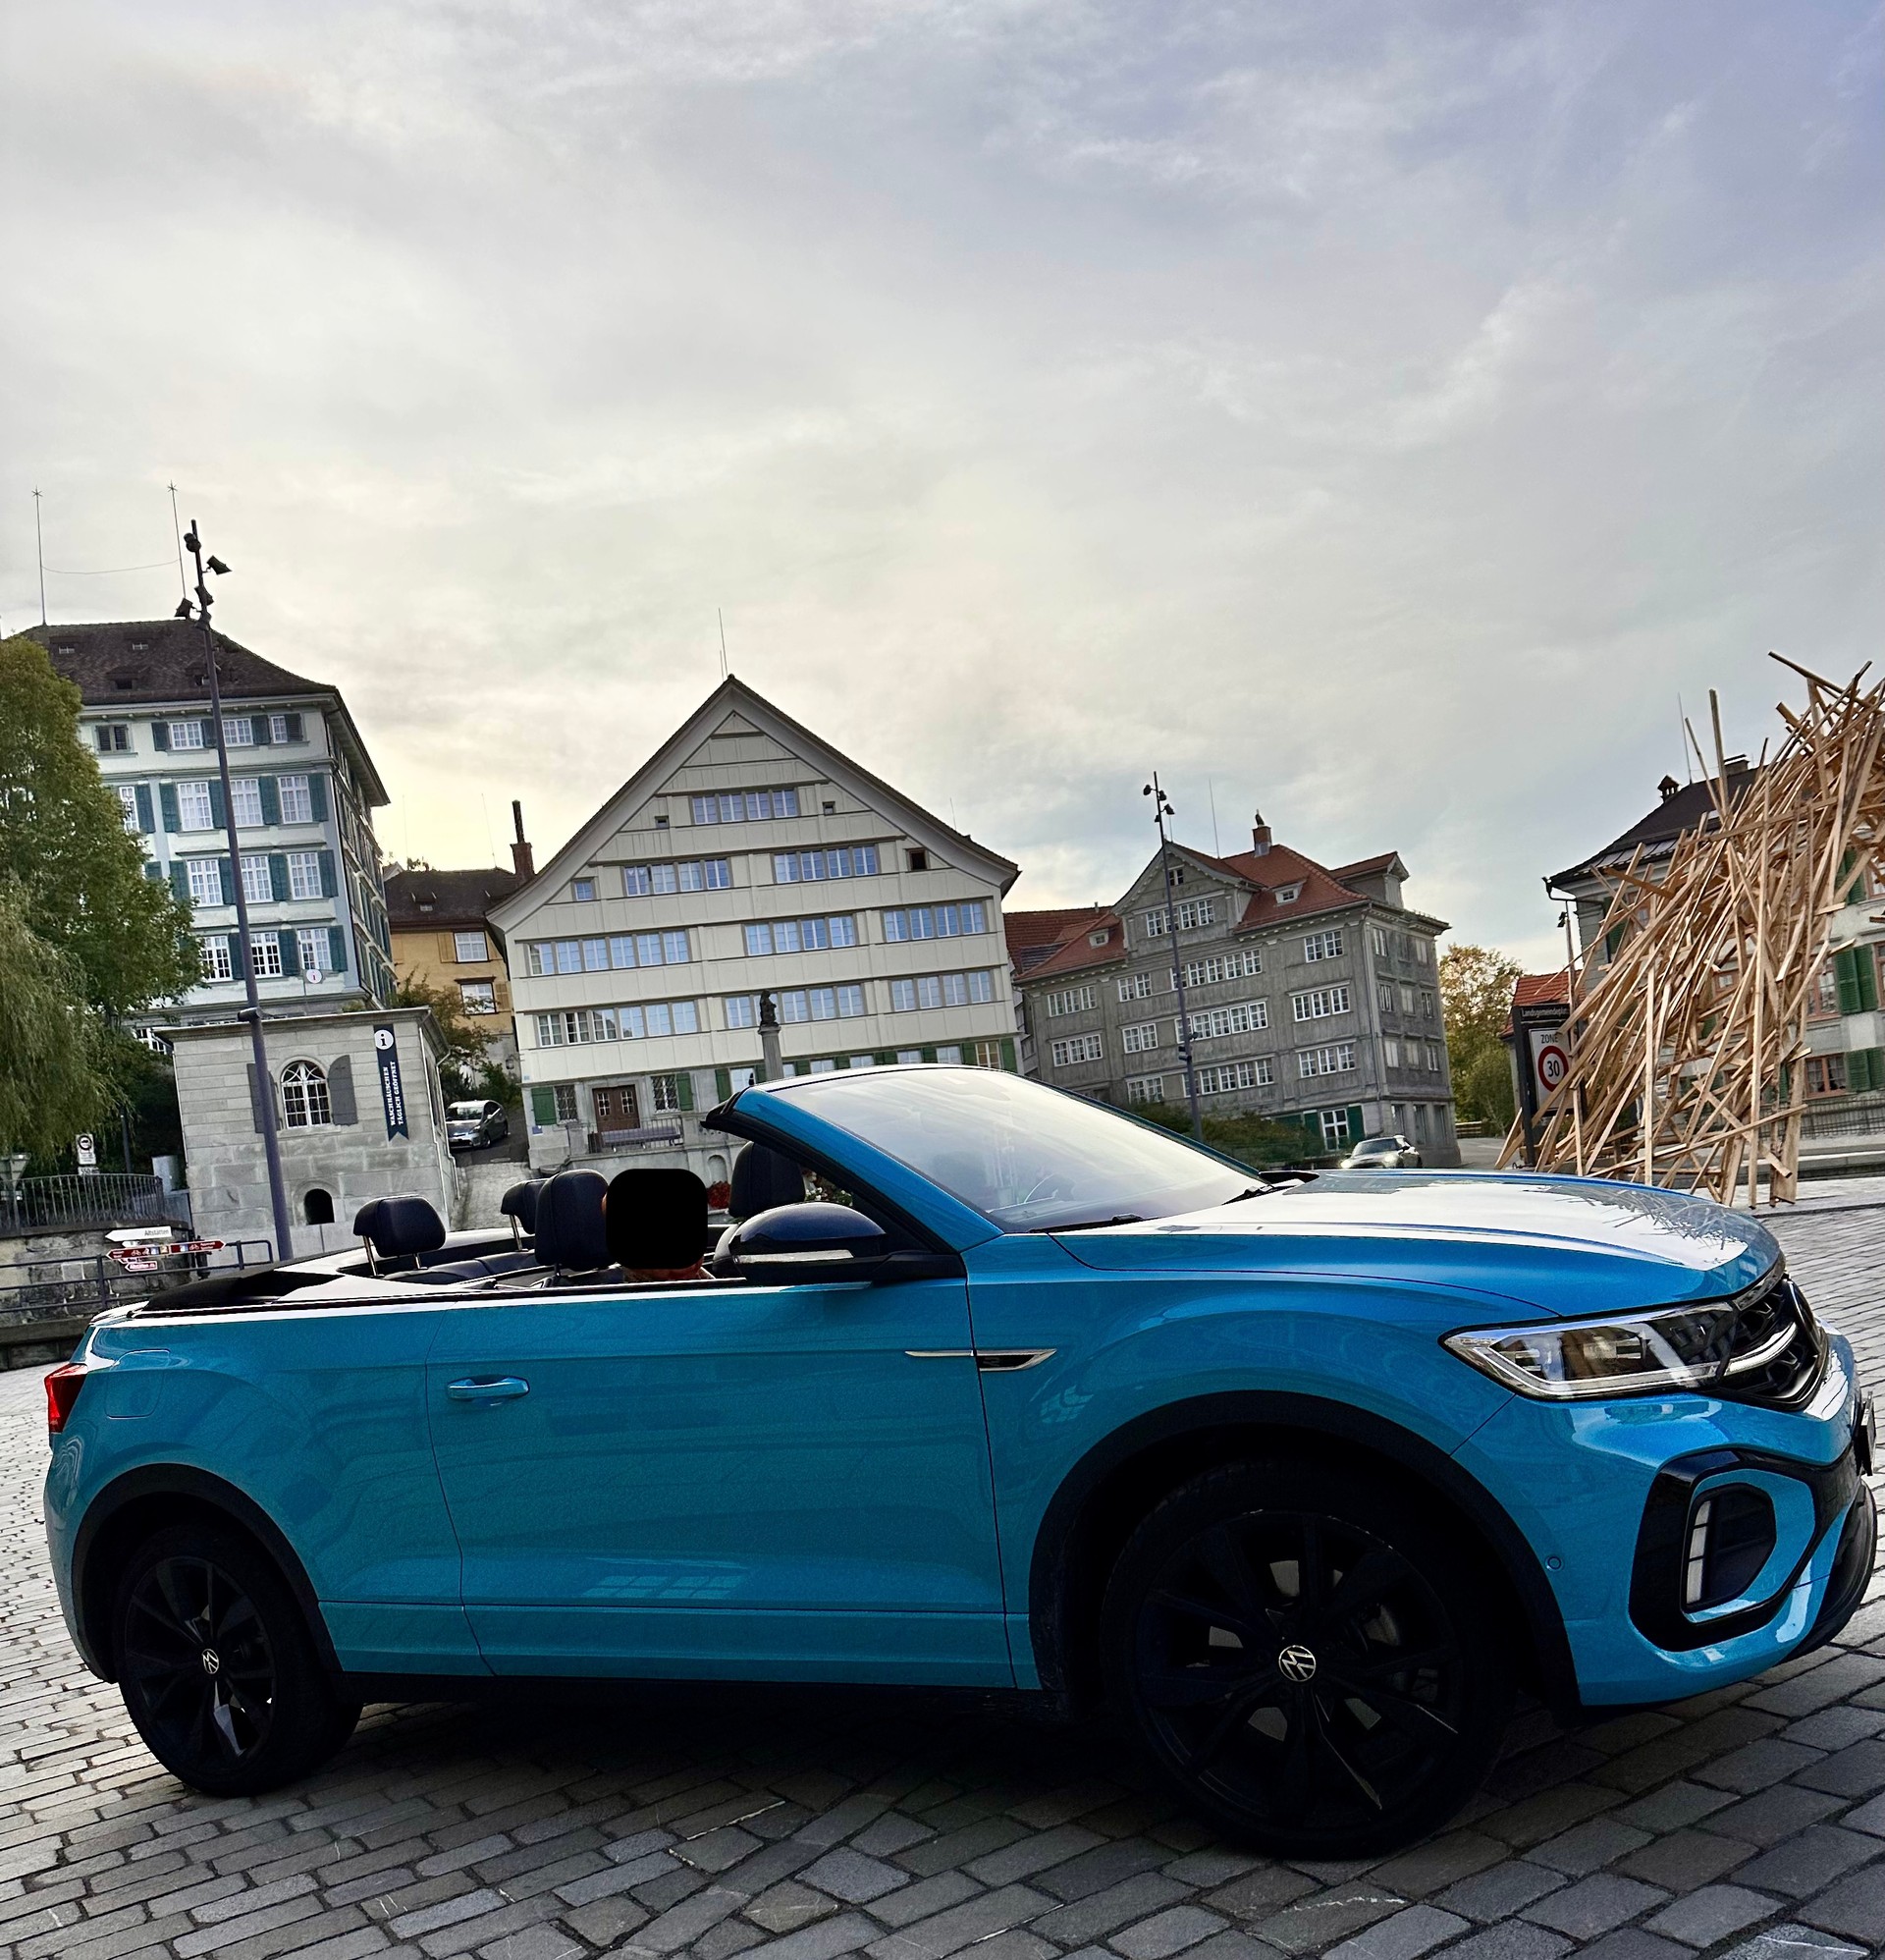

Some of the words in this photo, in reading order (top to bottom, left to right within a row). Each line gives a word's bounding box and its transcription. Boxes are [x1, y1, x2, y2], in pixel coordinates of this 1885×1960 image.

[1540, 1033, 1559, 1044] ZONE
[390, 1061, 400, 1094] GEÖFFNET
[1546, 1060, 1560, 1077] 30
[383, 1066, 396, 1126] WASCHHÄUSCHEN
[394, 1096, 404, 1125] TÄGLICH
